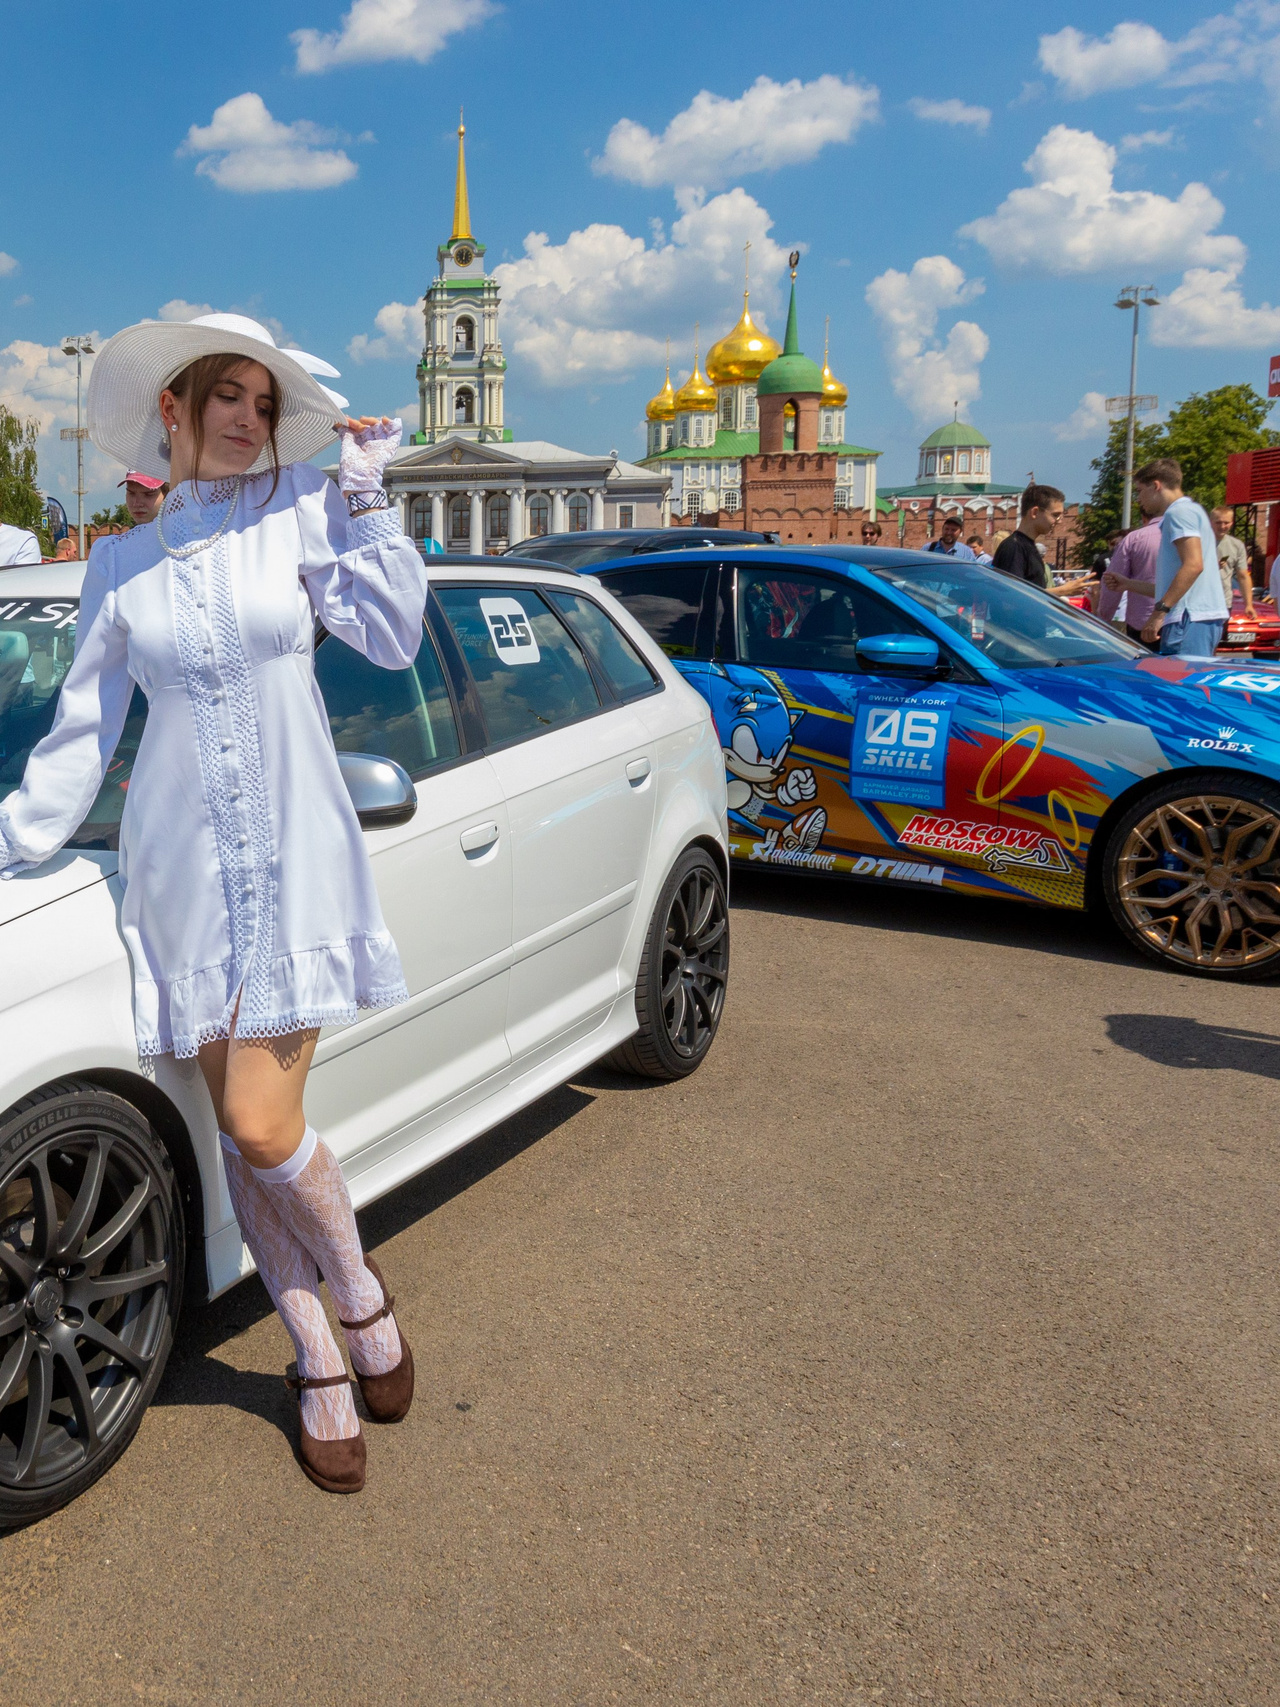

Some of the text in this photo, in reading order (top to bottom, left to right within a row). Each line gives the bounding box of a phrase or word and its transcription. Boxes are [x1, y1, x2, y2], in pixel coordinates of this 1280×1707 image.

[868, 695, 947, 706] @WHEATEN_YORK
[865, 707, 940, 749] 06
[1186, 738, 1256, 753] ROLEX
[862, 748, 933, 771] SKILL
[897, 768, 931, 777] WHEELS
[862, 788, 931, 800] BARMALEY.PRO
[863, 782, 930, 794] БАРМАЛЕЙ ДИЗАЙН
[906, 814, 1041, 849] MOSCOW
[896, 831, 990, 854] RACEWAY
[10, 1104, 80, 1150] MICHELIN
